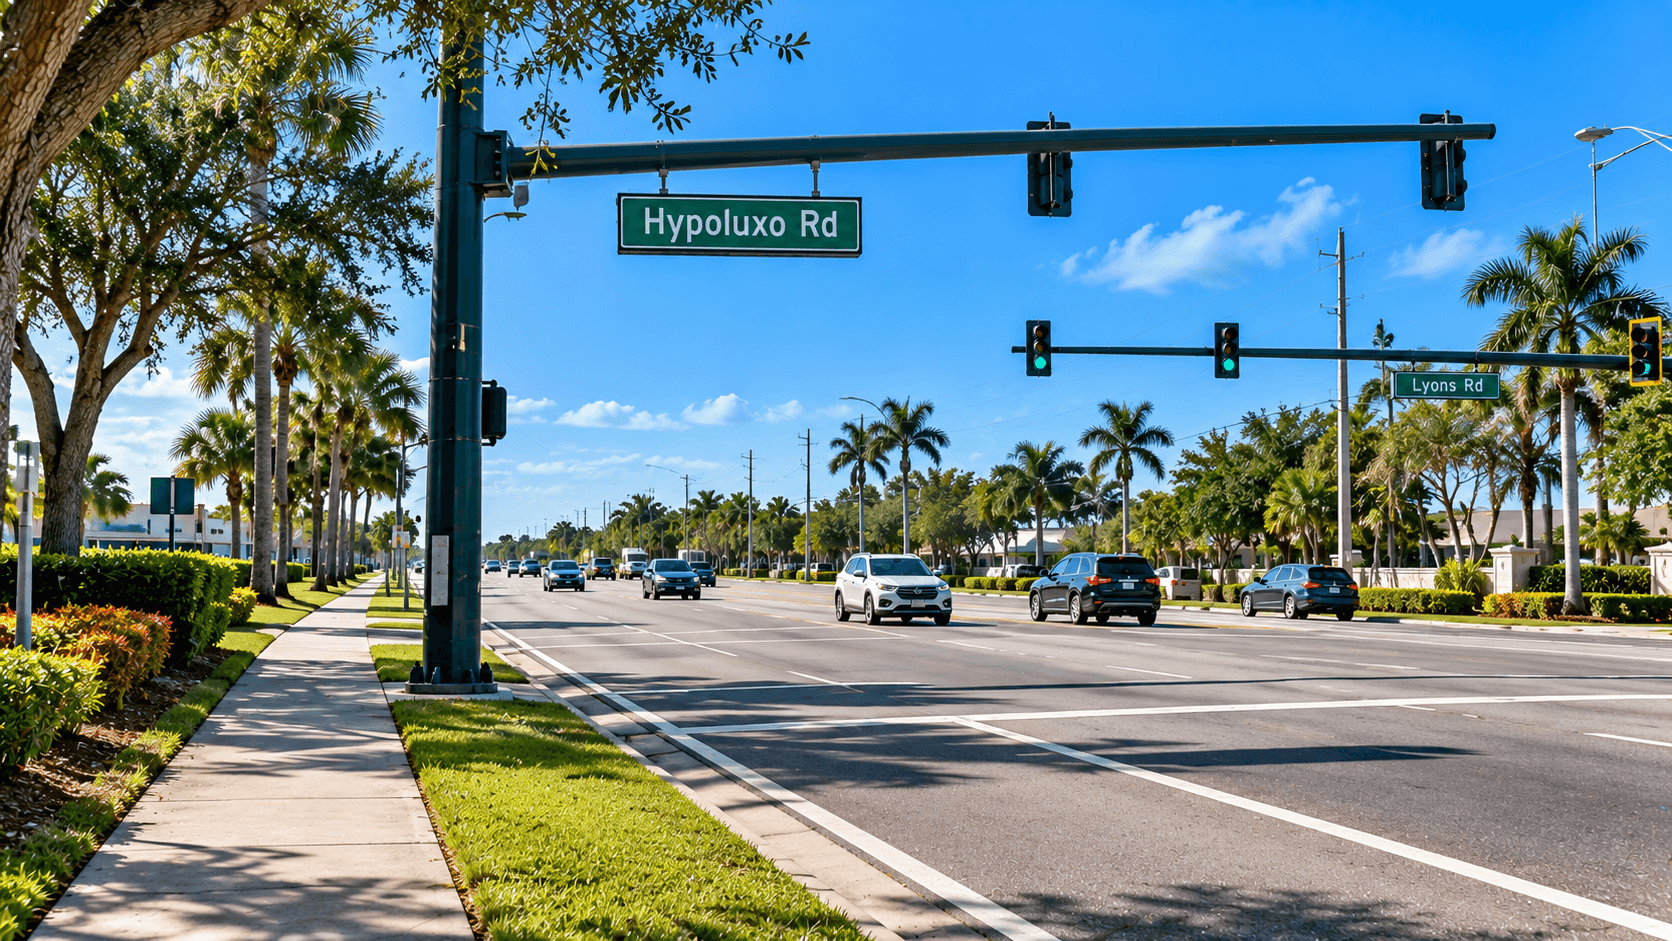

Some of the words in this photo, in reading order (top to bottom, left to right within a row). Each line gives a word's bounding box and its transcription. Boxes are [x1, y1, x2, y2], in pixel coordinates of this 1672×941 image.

[644, 207, 786, 243] Hypoluxo
[801, 209, 838, 238] Rd
[1413, 377, 1457, 395] Lyons
[1464, 378, 1483, 392] Rd
